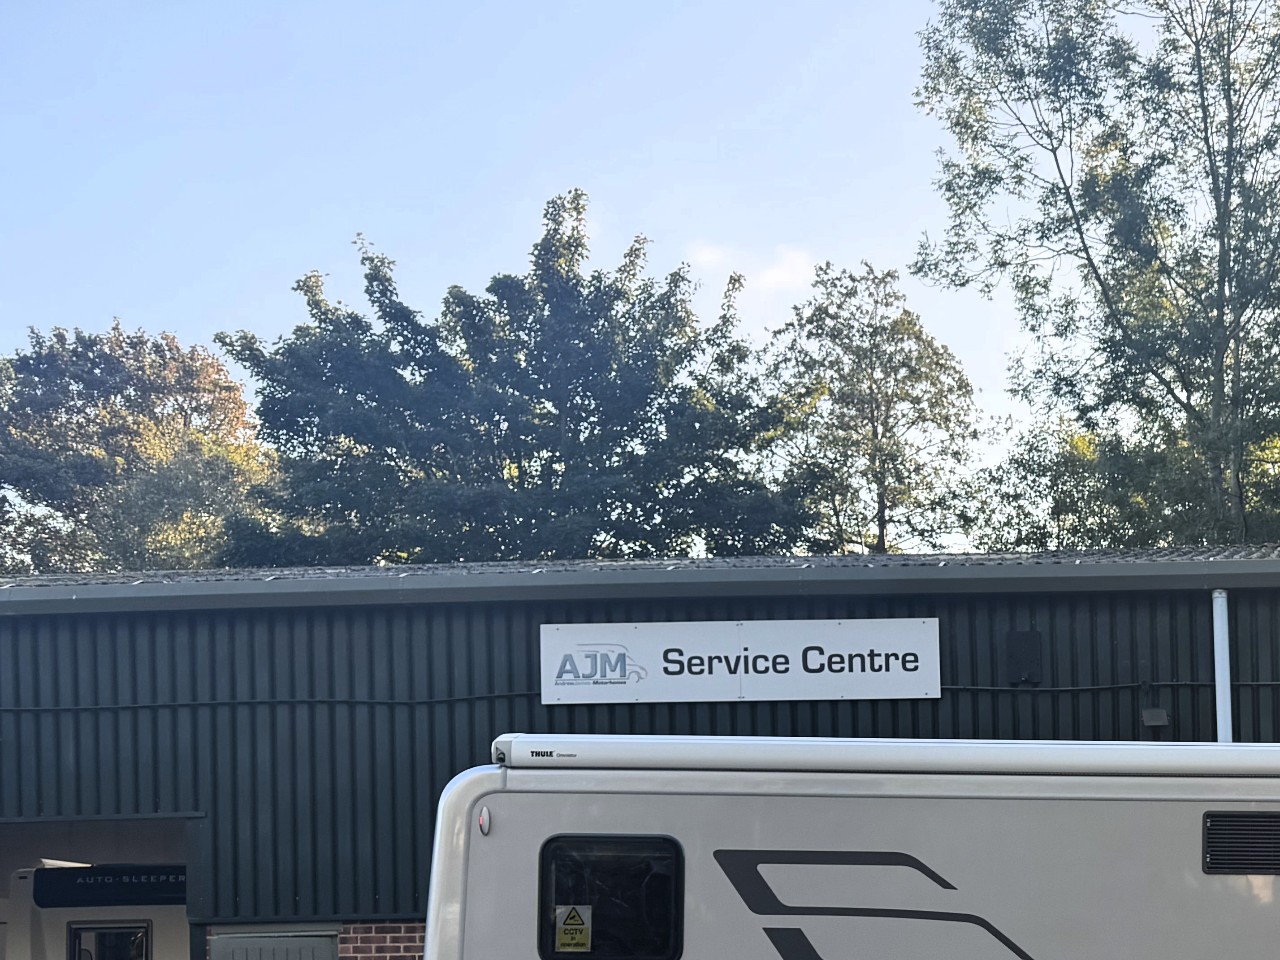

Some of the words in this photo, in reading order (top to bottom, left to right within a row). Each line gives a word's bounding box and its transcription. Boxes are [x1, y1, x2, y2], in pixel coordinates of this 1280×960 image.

[555, 652, 627, 679] AJM
[662, 647, 790, 676] Service
[801, 645, 919, 674] Centre
[530, 750, 554, 758] THULE
